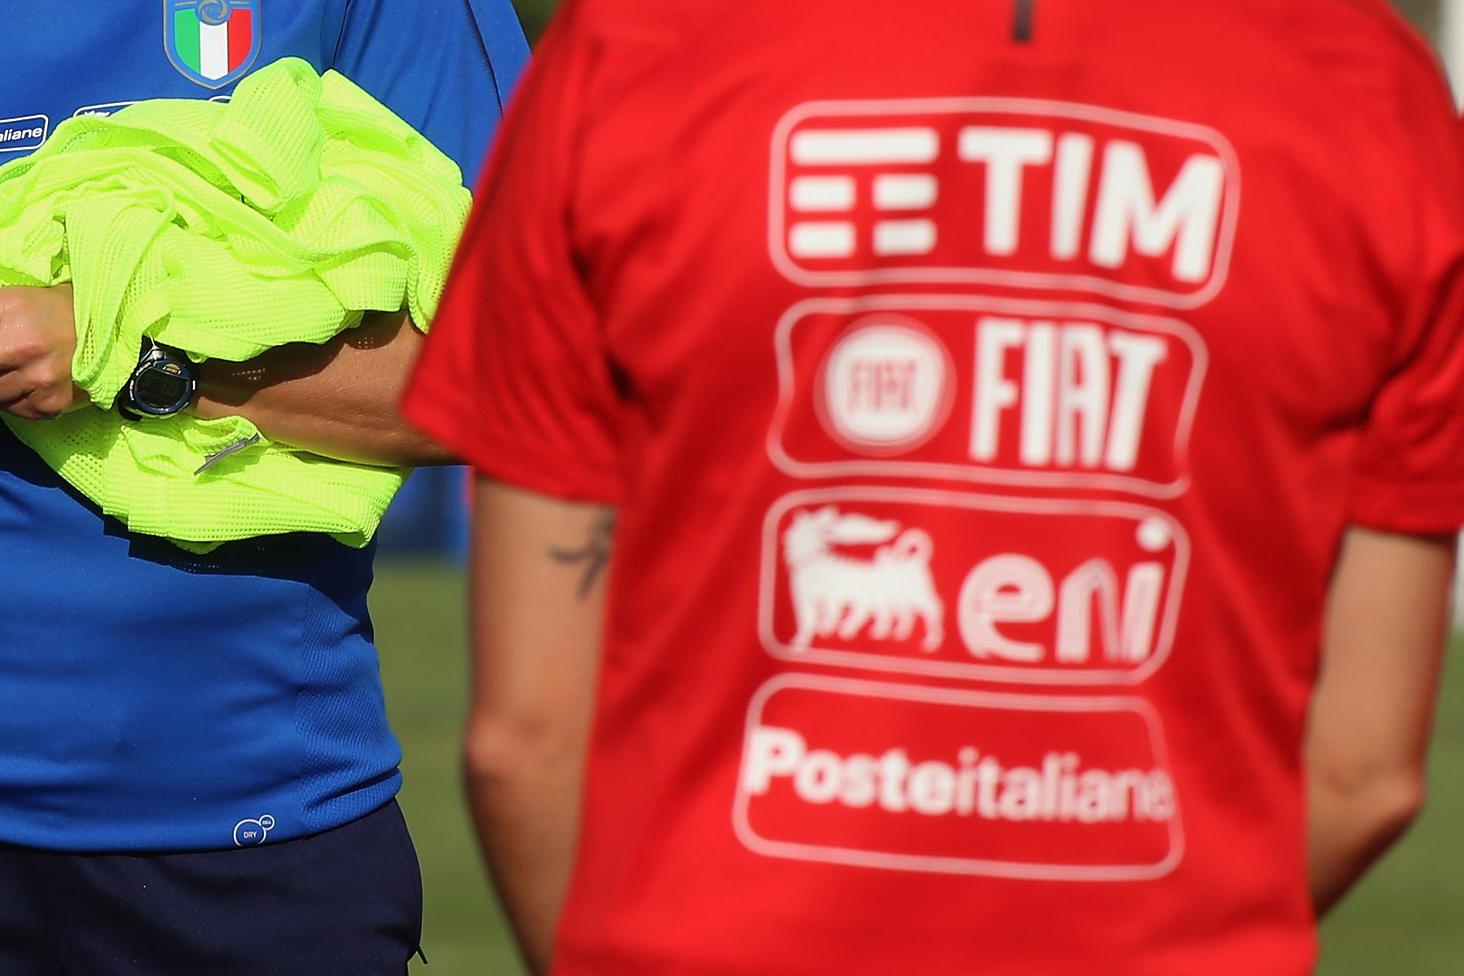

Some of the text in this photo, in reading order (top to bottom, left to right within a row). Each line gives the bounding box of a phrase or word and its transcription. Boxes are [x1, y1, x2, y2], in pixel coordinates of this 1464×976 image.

[958, 126, 1224, 283] TIM
[970, 318, 1167, 470] FIAT
[958, 521, 1171, 661] eni
[745, 726, 1175, 823] Posteitaliane
